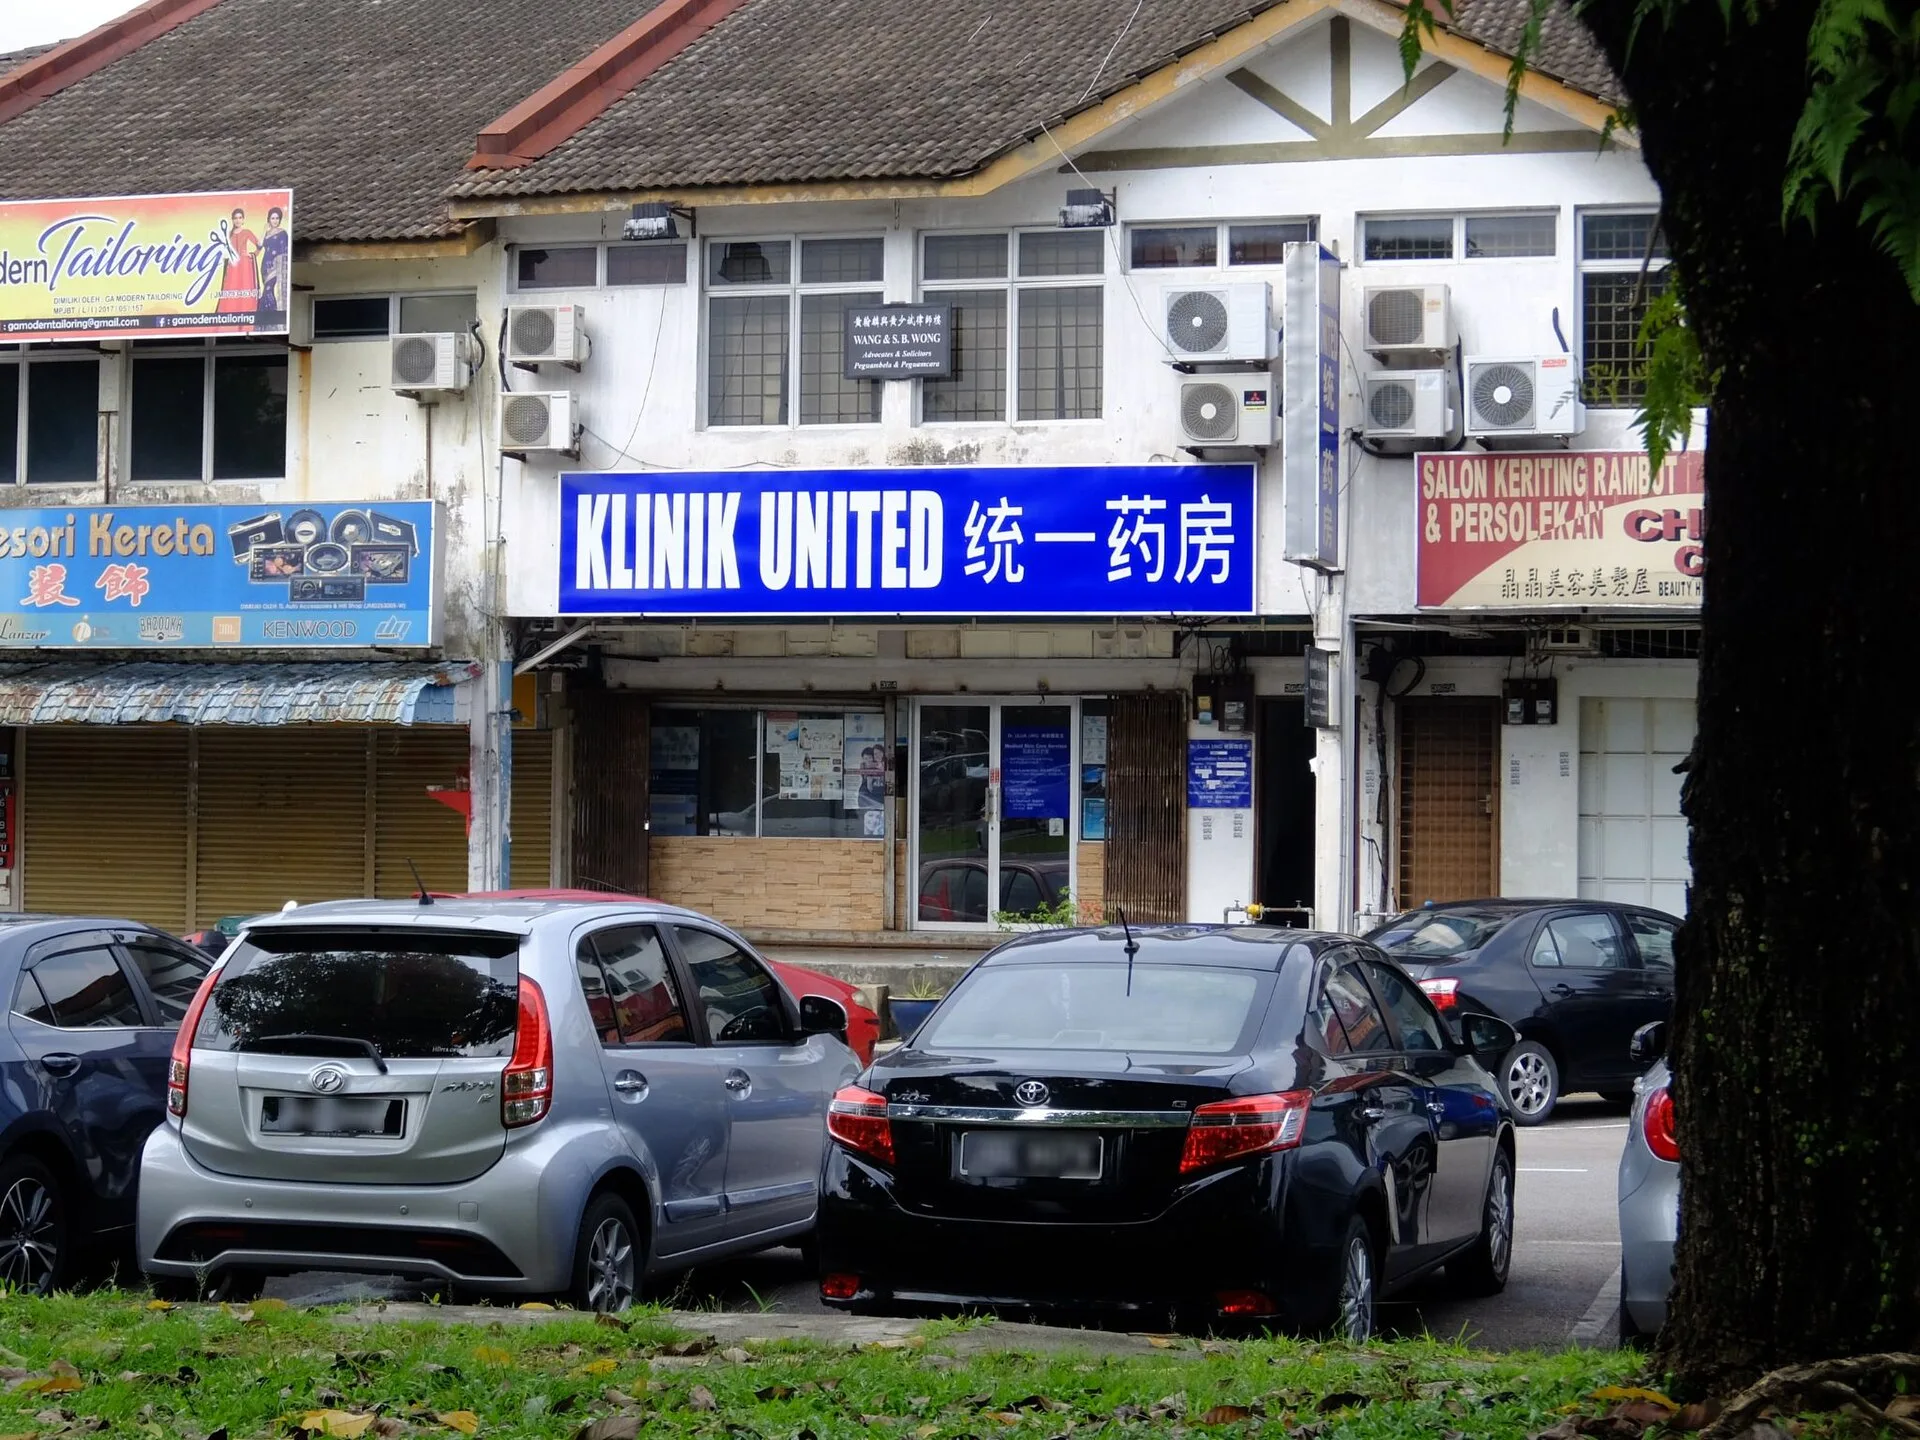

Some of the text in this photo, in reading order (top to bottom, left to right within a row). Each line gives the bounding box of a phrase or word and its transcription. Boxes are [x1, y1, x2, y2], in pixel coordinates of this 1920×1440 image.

[38, 216, 223, 306] Tailoring
[105, 295, 116, 303] GA
[116, 295, 146, 303] MODERN
[147, 293, 183, 302] TAILORING
[172, 313, 255, 327] gamoderntailoring
[853, 332, 941, 345] WANG & S. B. WONG
[862, 349, 932, 358] Advocates & Solicitors
[893, 361, 899, 369] &
[1423, 457, 1488, 500] SALON
[1494, 455, 1587, 498] KERITING
[1425, 500, 1604, 544] & PERSOLEKAN
[89, 512, 215, 558] Kereta
[576, 489, 1236, 591] KLINIK UNITED 统一药房
[1658, 581, 1692, 597] BEAUTY
[0, 618, 47, 640] Lanzar
[140, 616, 182, 632] BAZOOKA
[263, 620, 357, 639] KENWOOD
